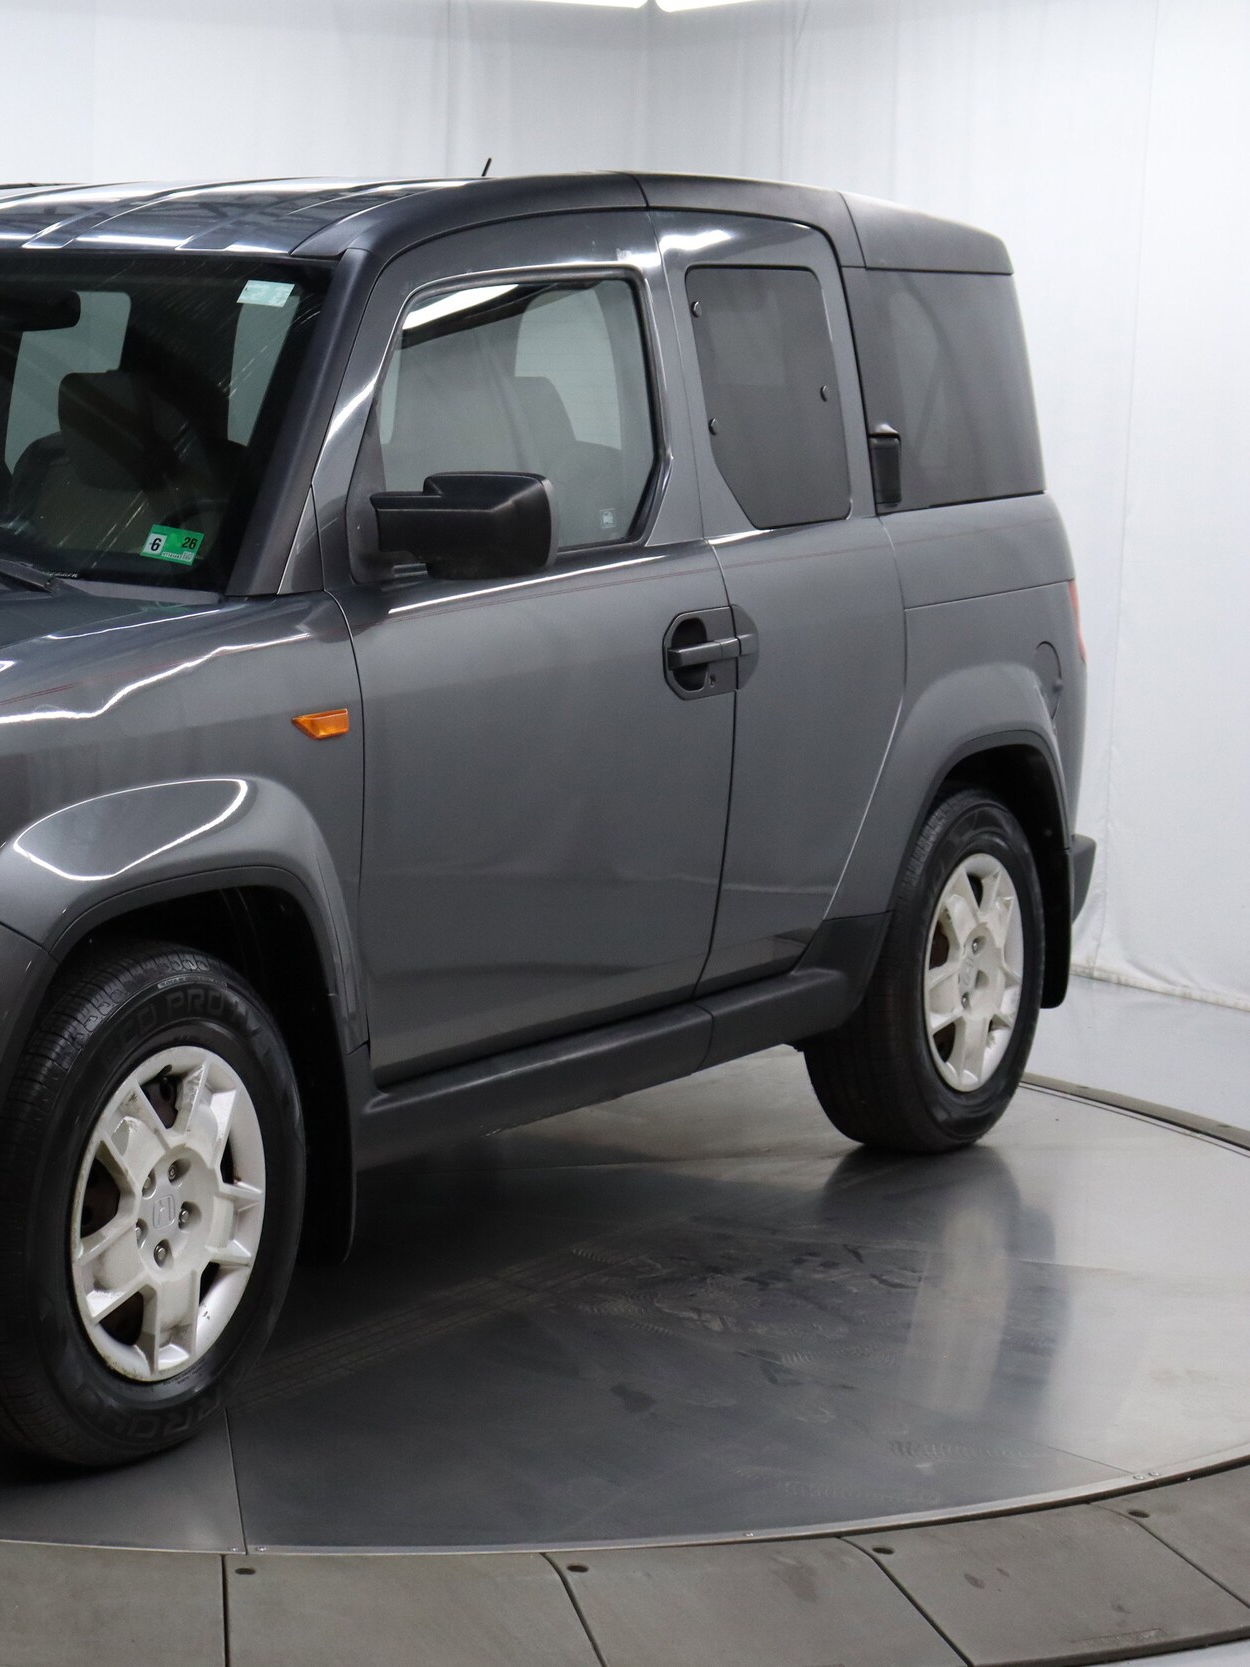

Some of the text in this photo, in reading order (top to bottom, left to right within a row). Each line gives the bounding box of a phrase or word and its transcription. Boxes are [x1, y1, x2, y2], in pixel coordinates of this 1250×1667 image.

[150, 536, 198, 551] 6 26
[166, 988, 225, 1019] PRO
